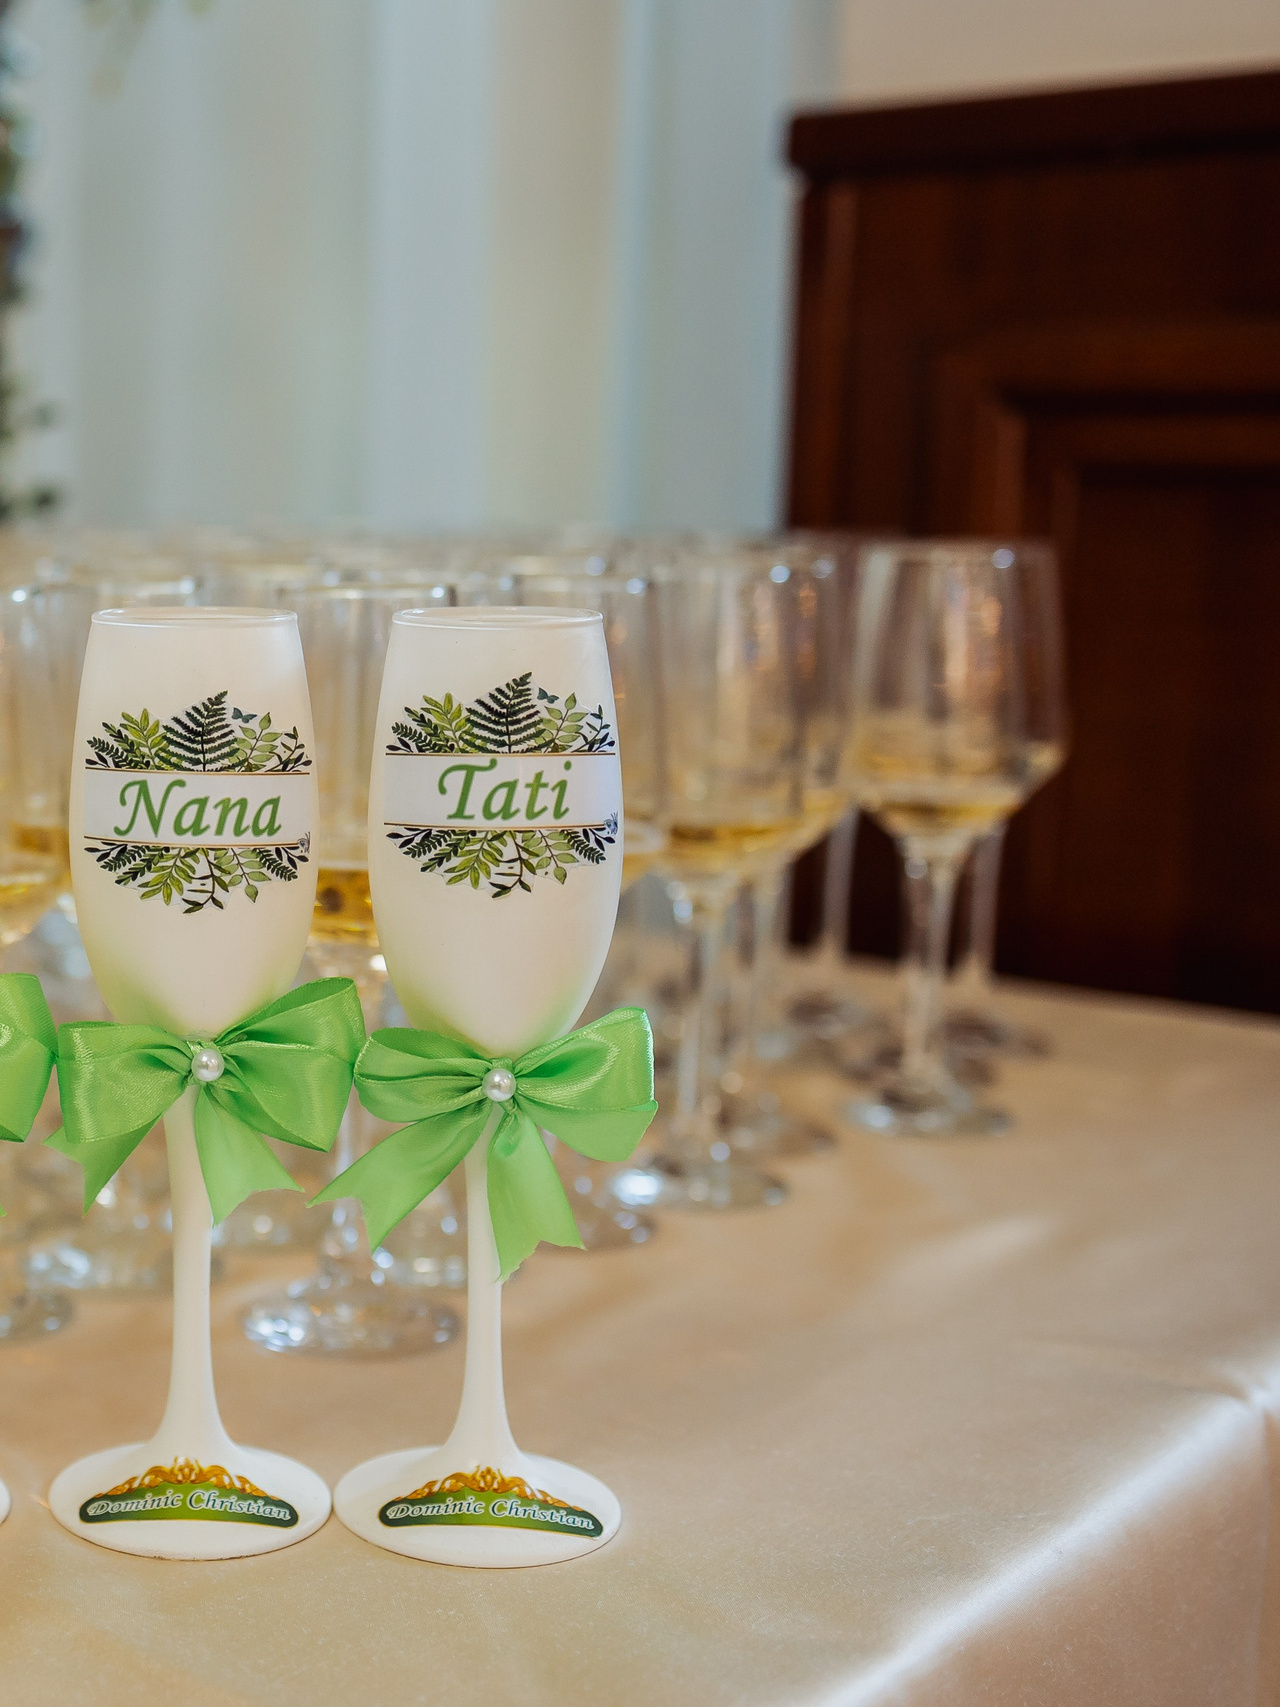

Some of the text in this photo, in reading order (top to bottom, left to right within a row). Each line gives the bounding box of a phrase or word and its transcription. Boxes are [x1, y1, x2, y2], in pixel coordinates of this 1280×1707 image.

[113, 778, 282, 838] Nana
[437, 757, 573, 821] Tati
[86, 1489, 291, 1520] Dominic Christian
[387, 1497, 594, 1530] Dominic Christian
